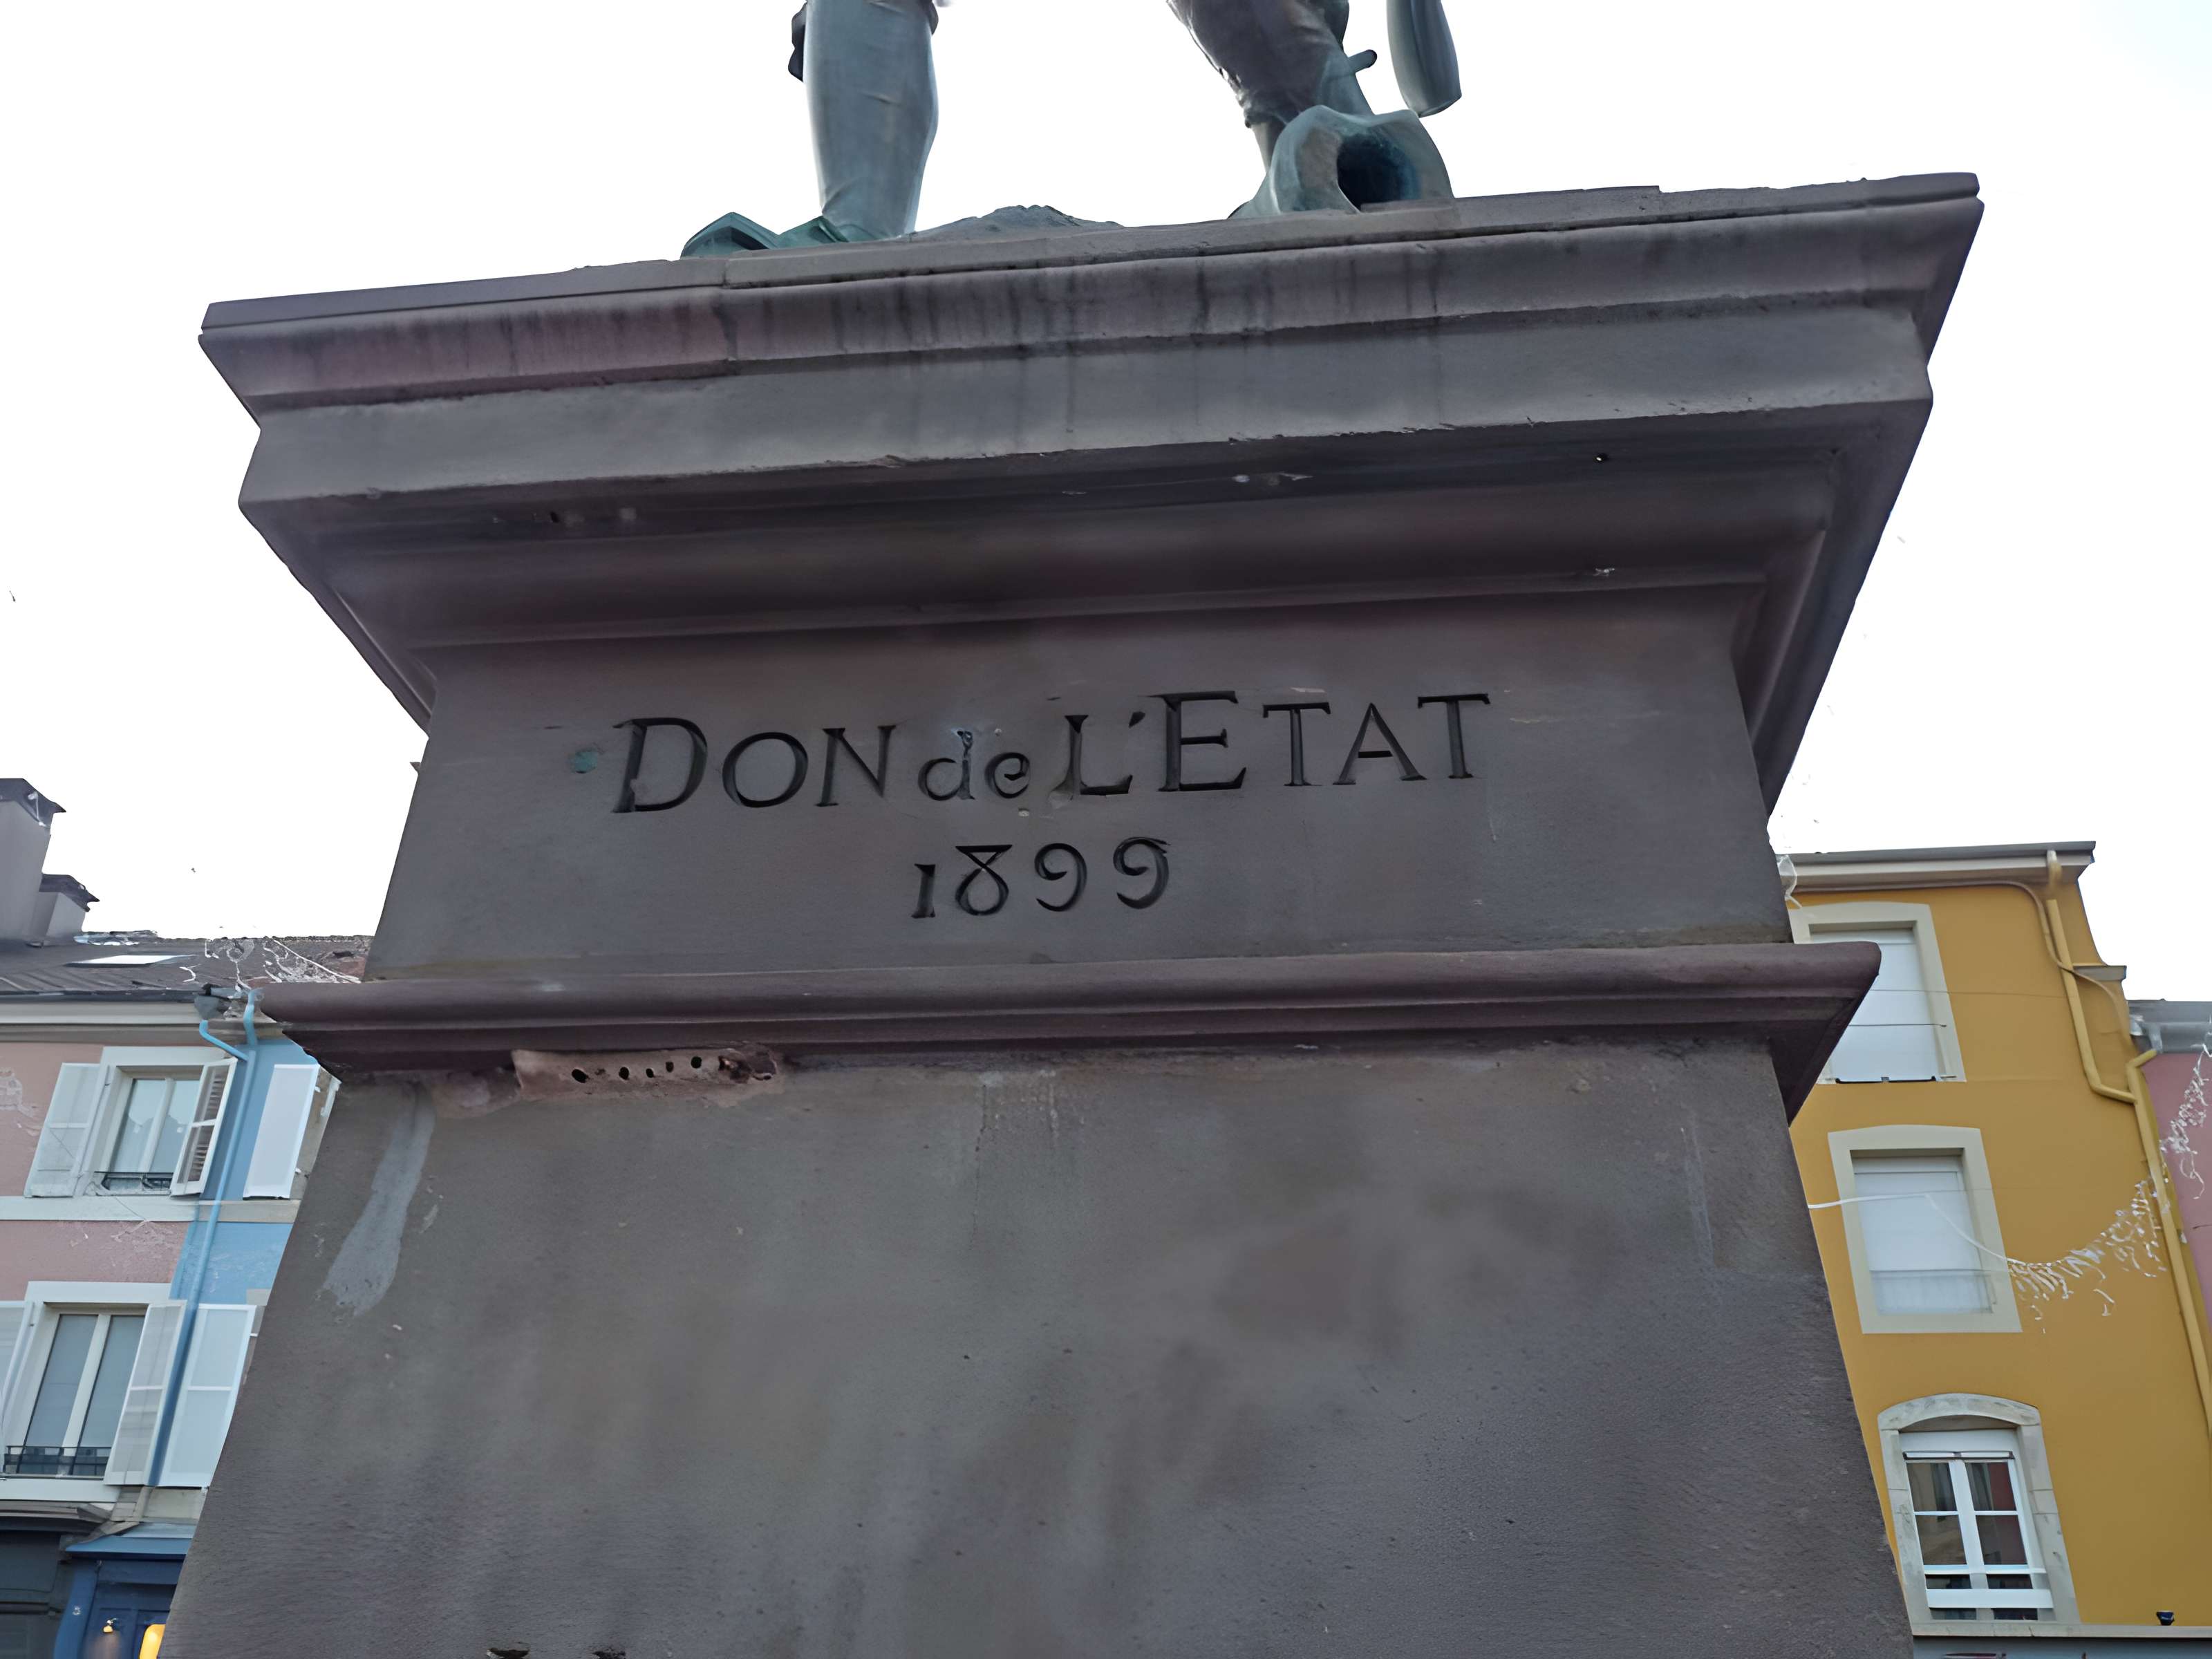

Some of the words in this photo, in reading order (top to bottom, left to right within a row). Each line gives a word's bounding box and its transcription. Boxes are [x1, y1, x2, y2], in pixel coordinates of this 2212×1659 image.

[612, 716, 897, 813] DON
[917, 728, 1031, 801] de
[1062, 690, 1492, 796] L'ETAT
[910, 836, 1171, 919] 1899
